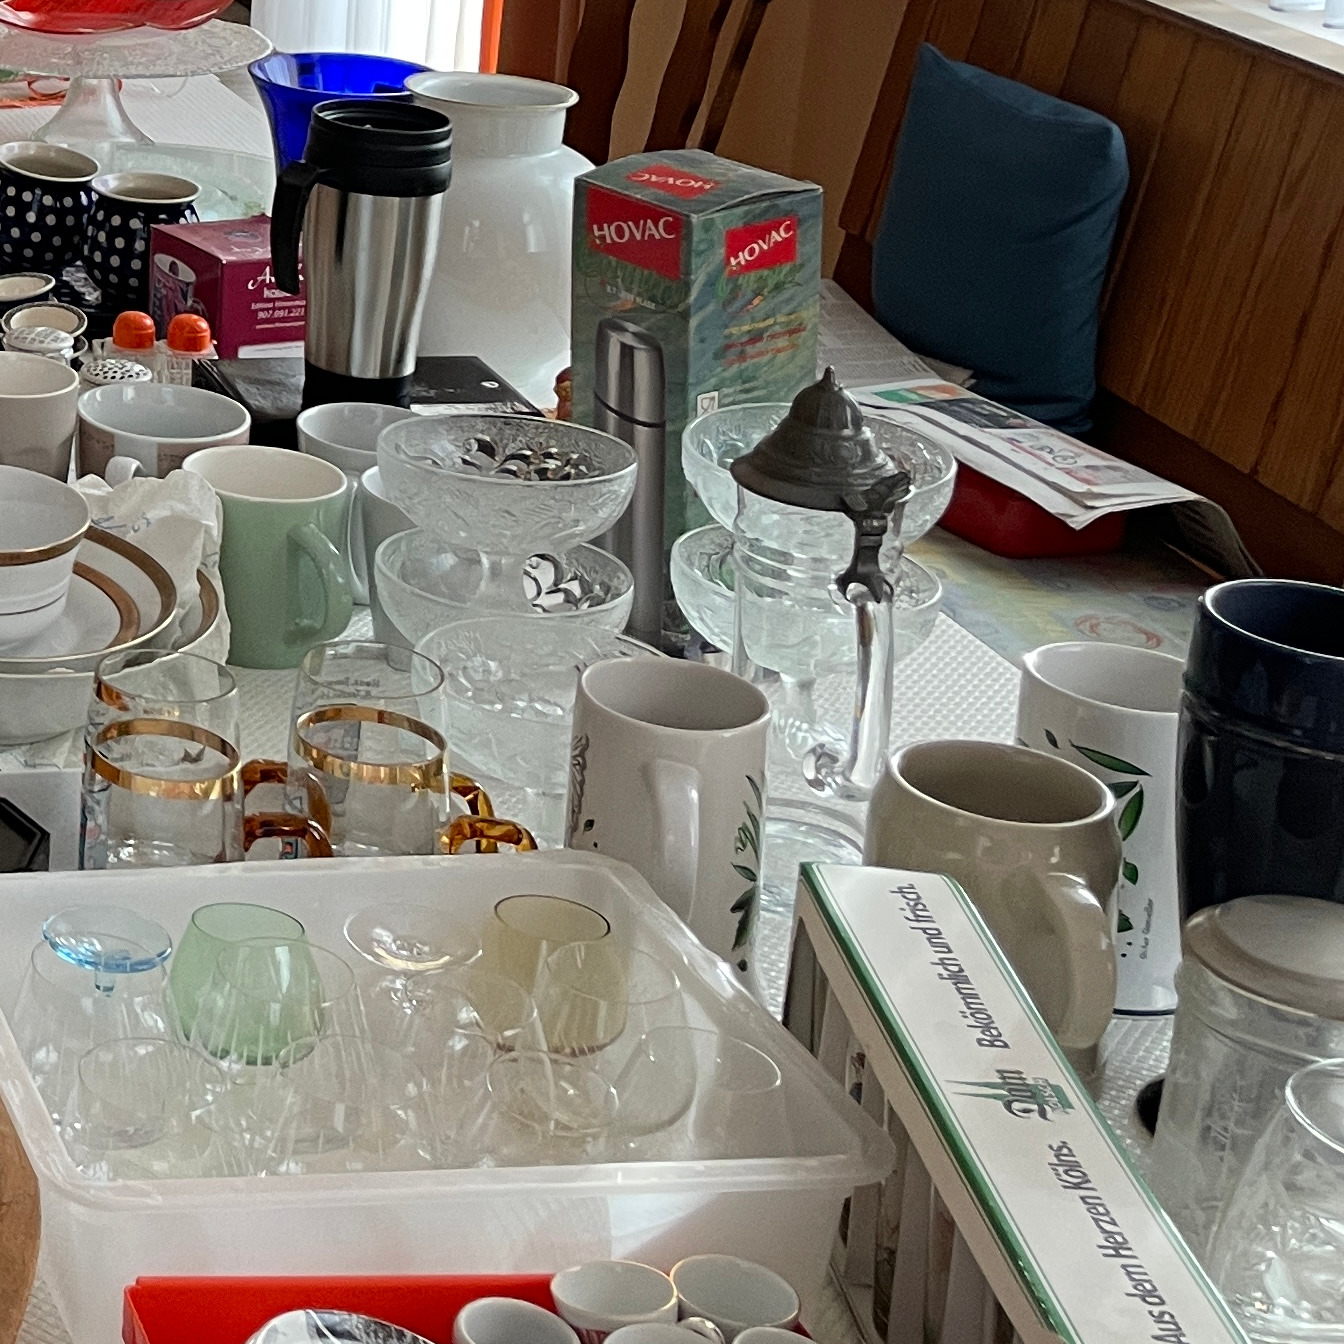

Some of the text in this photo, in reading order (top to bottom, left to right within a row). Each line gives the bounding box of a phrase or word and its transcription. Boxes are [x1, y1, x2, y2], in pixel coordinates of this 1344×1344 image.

[632, 171, 715, 190] HOVAC
[592, 216, 677, 245] HOVAC
[729, 220, 795, 271] HOVAC
[888, 882, 1011, 1050] Bekömmlich und frisch.
[1047, 1140, 1192, 1344] Aus dem Herzen Kölns.
